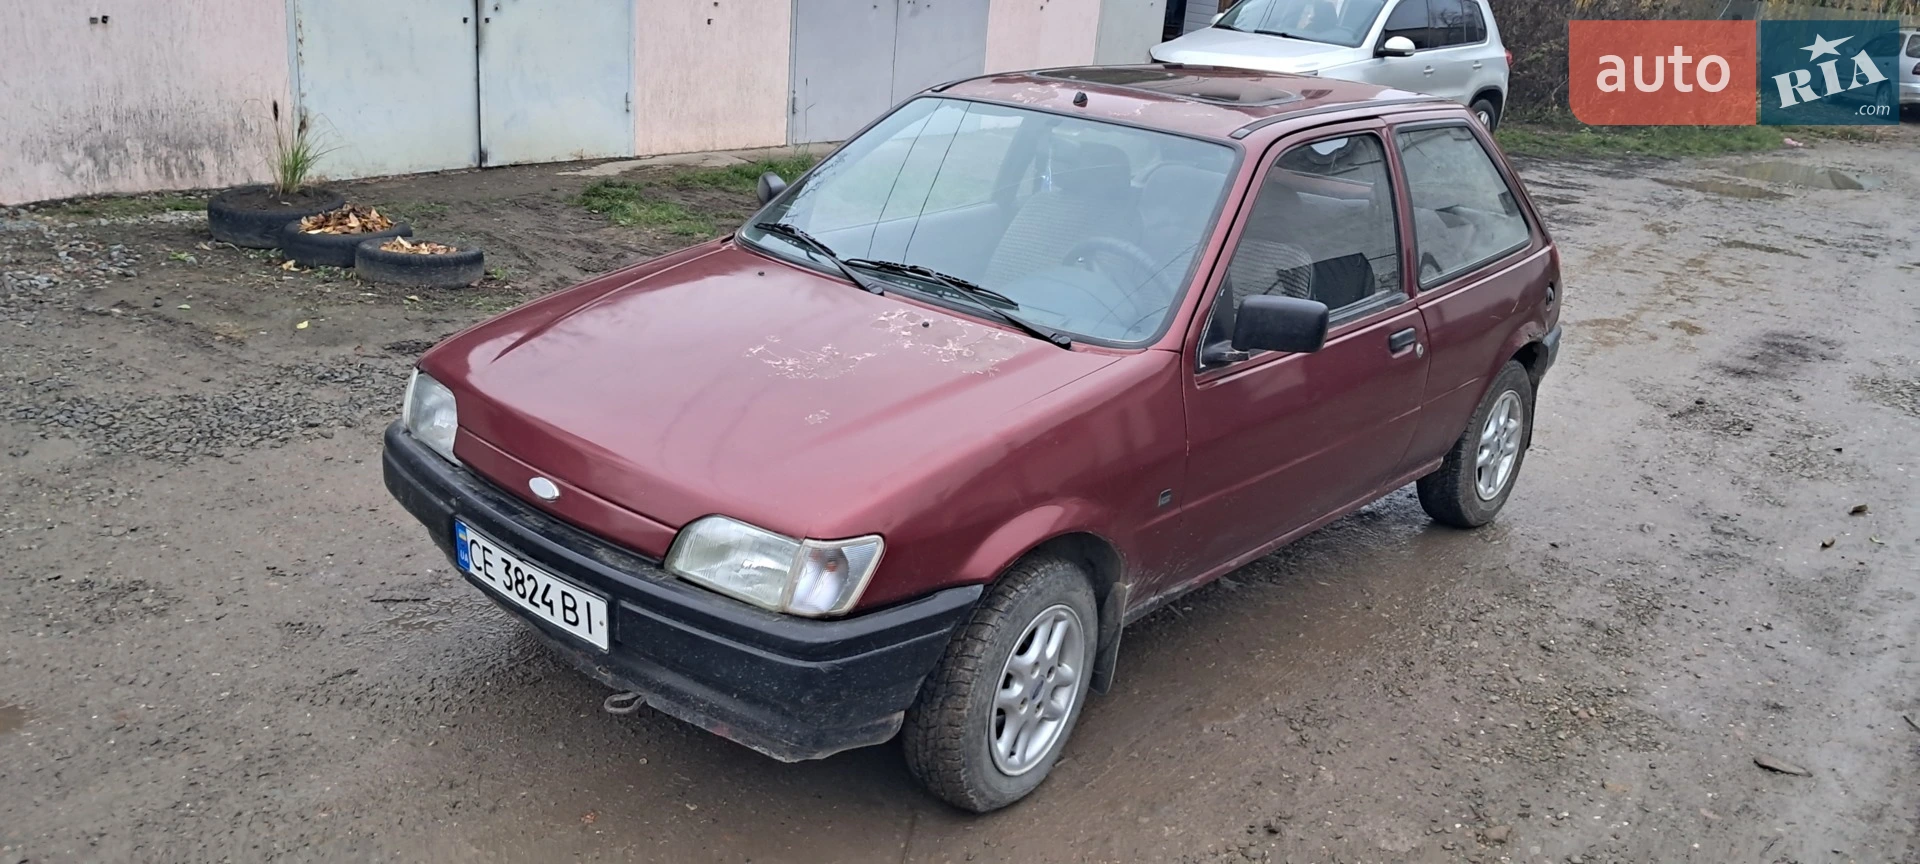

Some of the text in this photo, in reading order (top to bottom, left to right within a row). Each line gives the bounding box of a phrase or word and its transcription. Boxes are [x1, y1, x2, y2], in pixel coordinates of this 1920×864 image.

[460, 552, 469, 564] UA
[469, 539, 592, 635] CE 3824 BI
